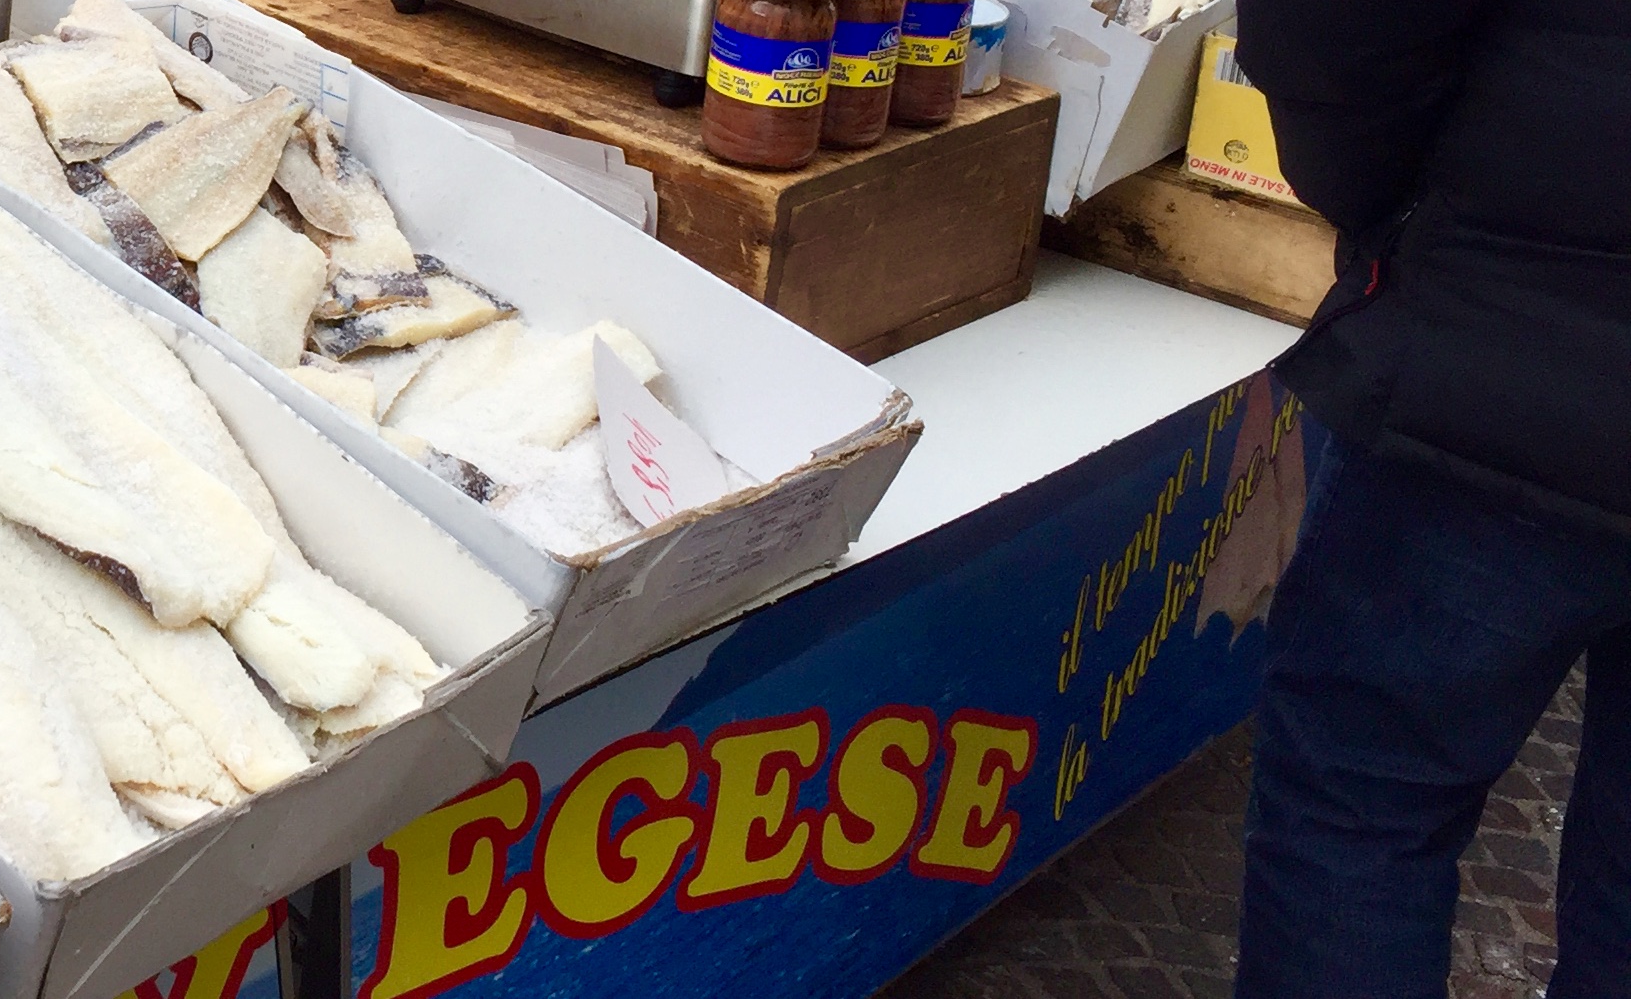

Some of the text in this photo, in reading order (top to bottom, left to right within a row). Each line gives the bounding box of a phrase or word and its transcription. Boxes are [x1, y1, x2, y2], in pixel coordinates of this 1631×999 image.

[766, 85, 822, 104] ALICI
[1190, 157, 1230, 177] MENO
[1232, 168, 1248, 182] IN
[1249, 173, 1286, 195] SALE
[1095, 448, 1194, 632] tempo
